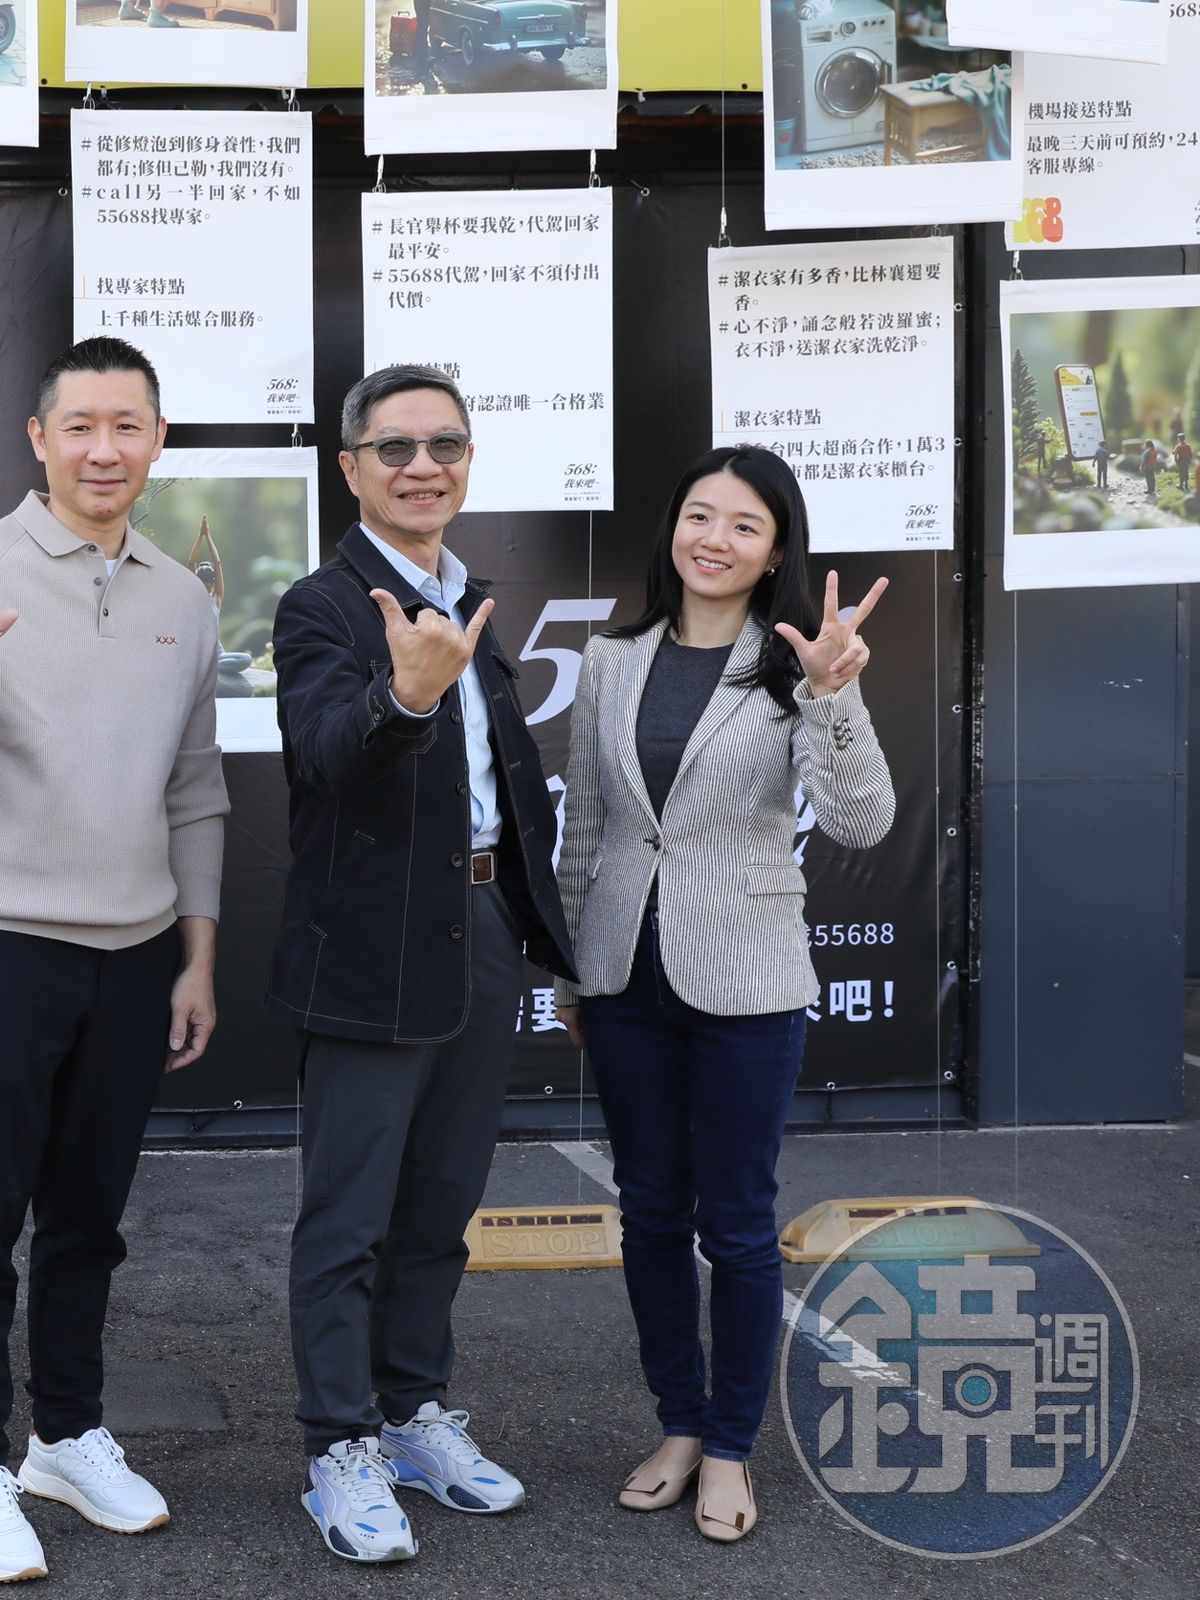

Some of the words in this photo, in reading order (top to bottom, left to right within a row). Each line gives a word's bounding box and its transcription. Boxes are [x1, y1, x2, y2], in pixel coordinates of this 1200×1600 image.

[1028, 100, 1132, 120] 機場接送特點
[97, 277, 186, 295] 找專家特點
[734, 409, 822, 428] 潔衣家特點
